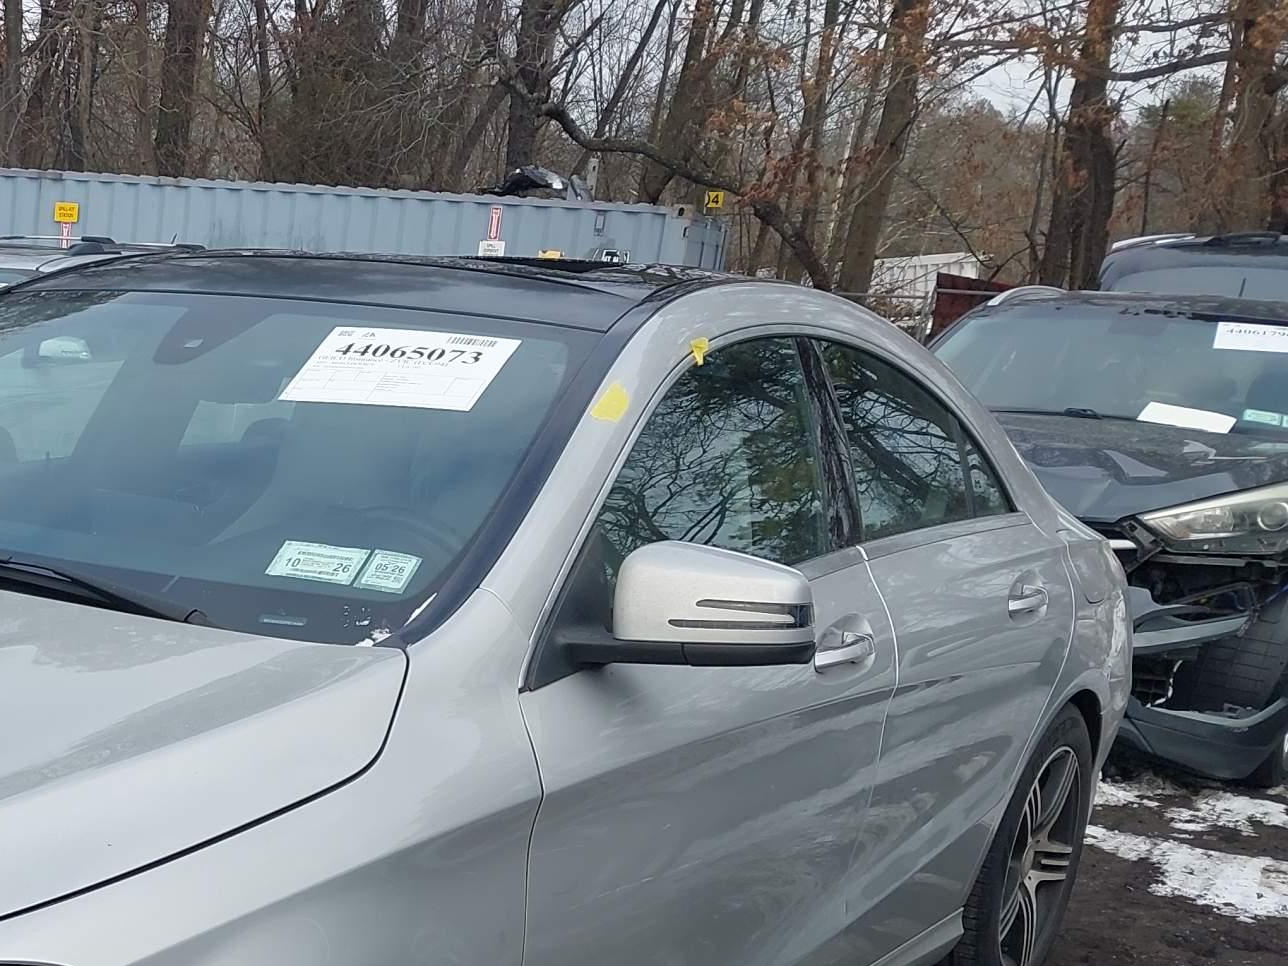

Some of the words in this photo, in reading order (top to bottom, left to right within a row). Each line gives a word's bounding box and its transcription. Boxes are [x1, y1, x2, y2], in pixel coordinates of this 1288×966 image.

[335, 342, 483, 364] 44065073
[284, 557, 301, 568] 10
[332, 562, 352, 574] 26
[375, 563, 389, 571] 05
[392, 564, 406, 574] 26
